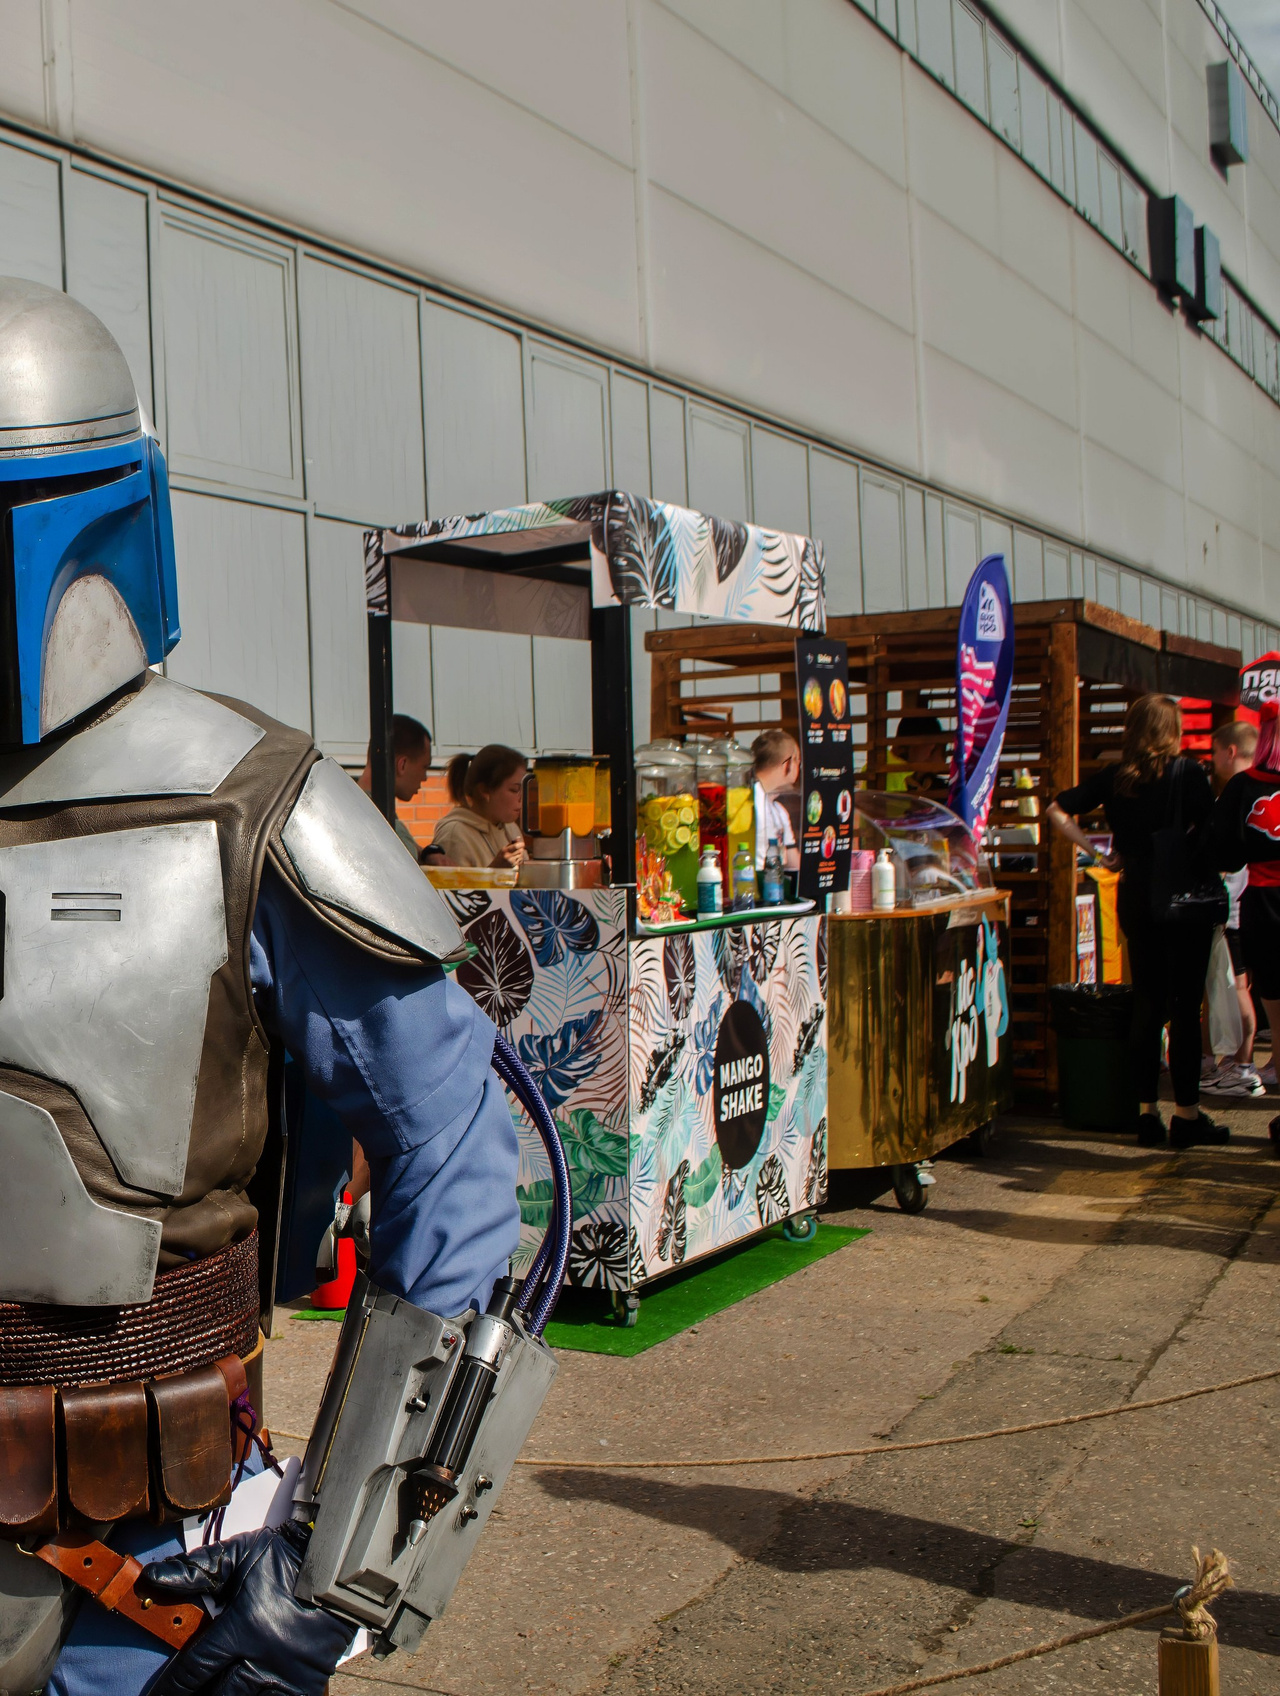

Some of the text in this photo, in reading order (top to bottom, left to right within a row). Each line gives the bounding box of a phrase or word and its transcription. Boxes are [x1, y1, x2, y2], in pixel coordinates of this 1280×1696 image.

[1242, 668, 1280, 690] ПЯ
[1258, 685, 1280, 704] С
[719, 1053, 764, 1089] MANGO
[719, 1083, 764, 1122] SHAKE
